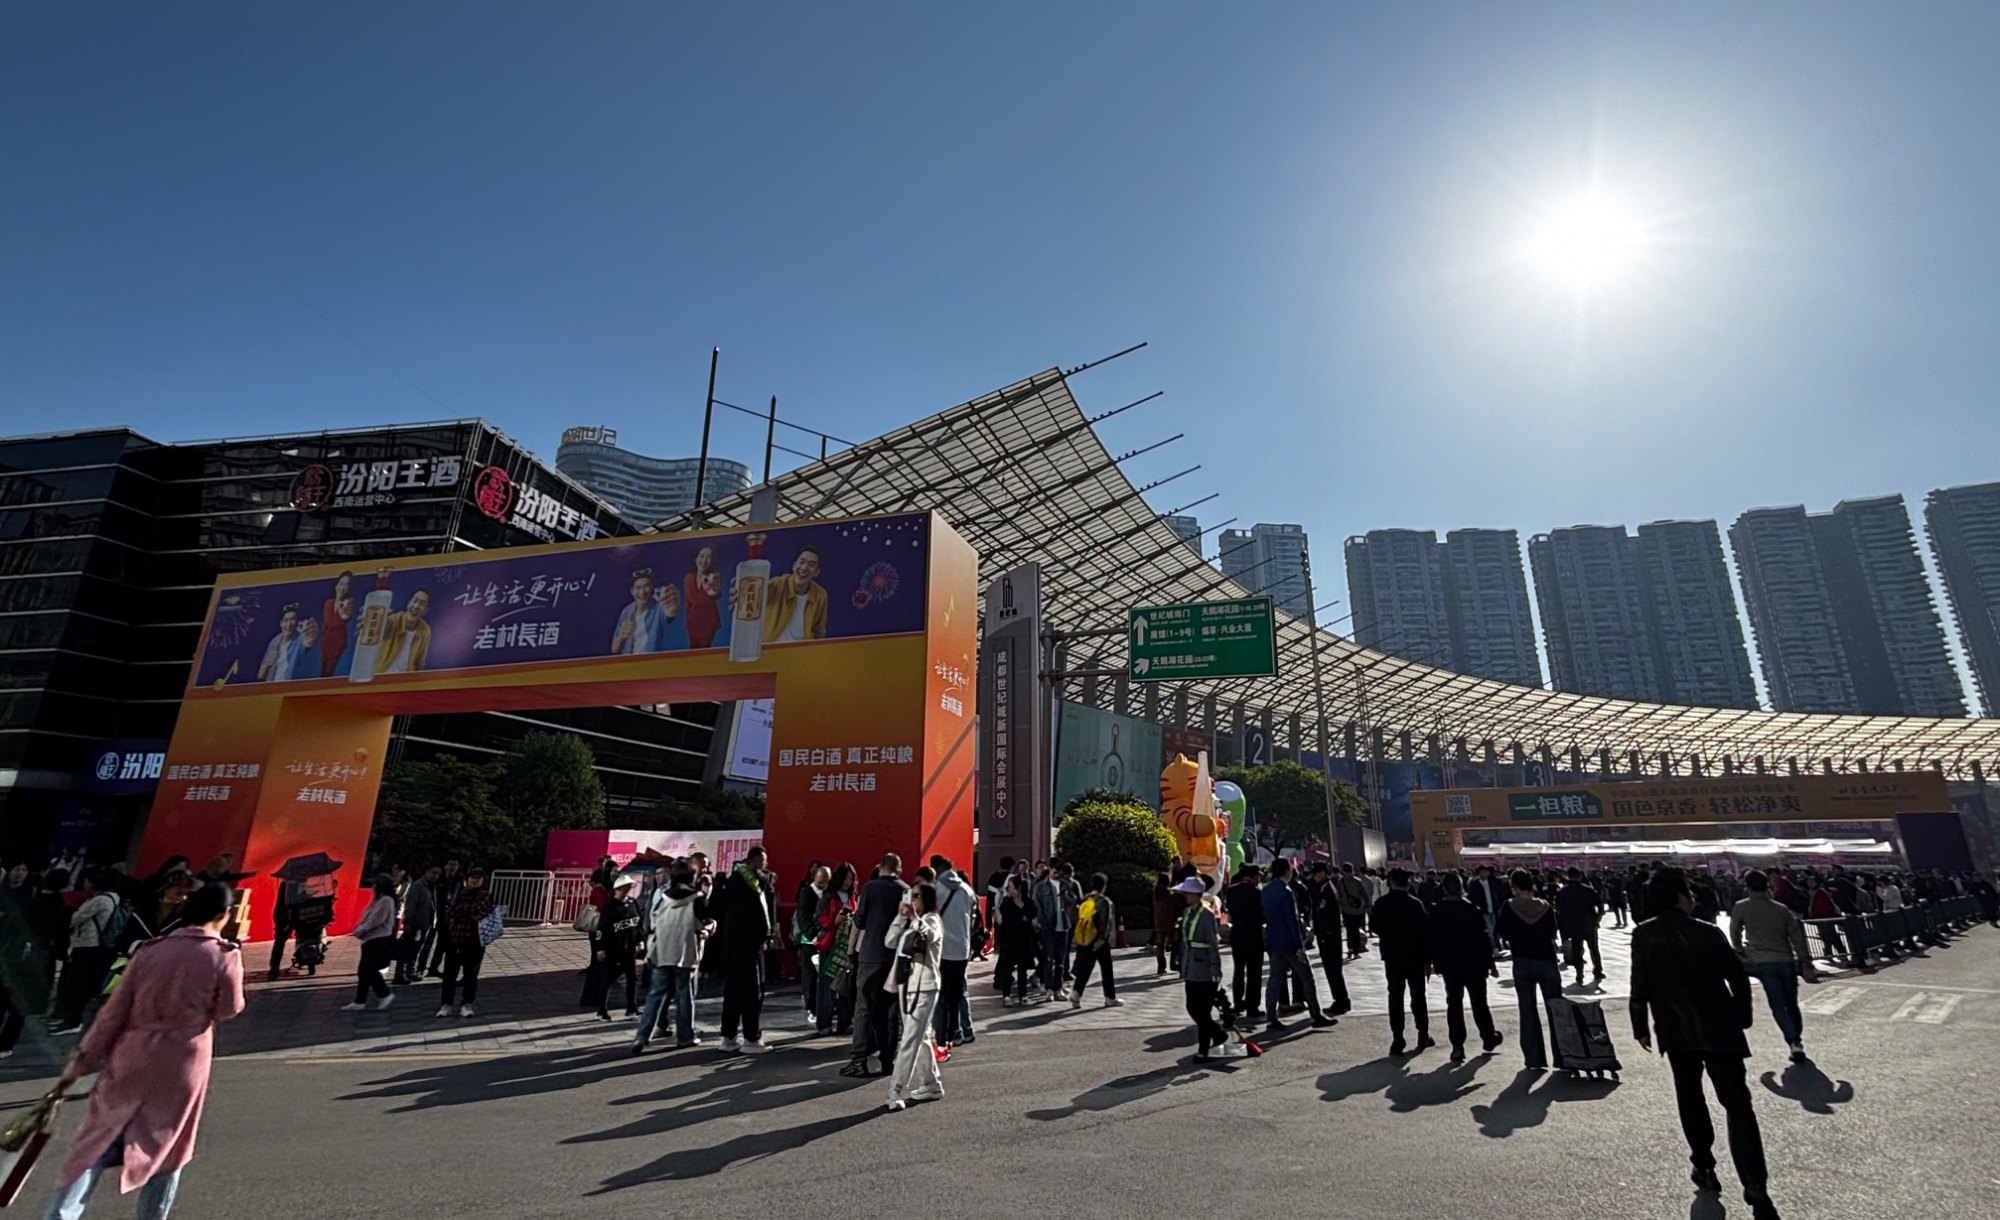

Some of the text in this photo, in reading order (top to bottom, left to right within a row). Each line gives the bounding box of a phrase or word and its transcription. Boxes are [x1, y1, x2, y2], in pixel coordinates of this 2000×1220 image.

[335, 455, 462, 495] 汾阳王酒
[333, 493, 396, 508] 西南运营中心
[514, 482, 599, 541] 汾阳王酒
[510, 513, 556, 544] 西南运营中心
[473, 621, 560, 650] 老村長酒
[996, 651, 1007, 819] 成都世纪城新国际会展中心
[779, 747, 842, 767] 国民白酒
[846, 745, 913, 764] 真正纯粮
[1252, 732, 1264, 765] 2
[119, 753, 165, 779] 汾阳
[167, 764, 213, 780] 国民白酒
[1532, 764, 1546, 787] 3
[809, 773, 876, 792] 老村長酒
[1515, 795, 1586, 816] 一担粮
[1613, 795, 1803, 818] 国色京香·轻松净爽
